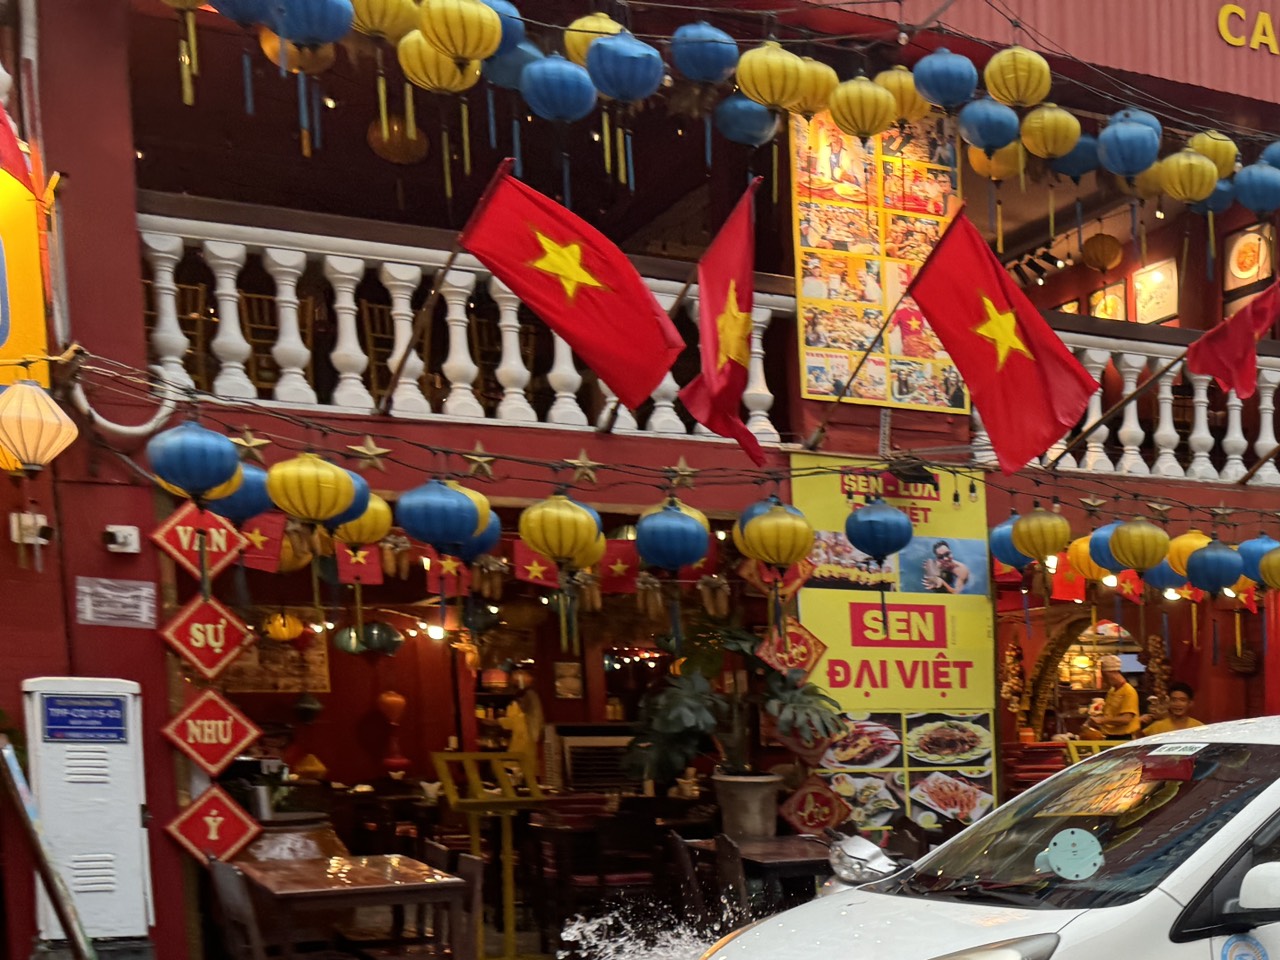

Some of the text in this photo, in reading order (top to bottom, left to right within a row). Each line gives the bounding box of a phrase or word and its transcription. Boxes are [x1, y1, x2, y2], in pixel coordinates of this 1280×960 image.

[189, 618, 228, 654] SỰ
[863, 609, 935, 642] SEN
[826, 651, 974, 698] ĐẠI VIỆT
[186, 715, 234, 744] NHƯ
